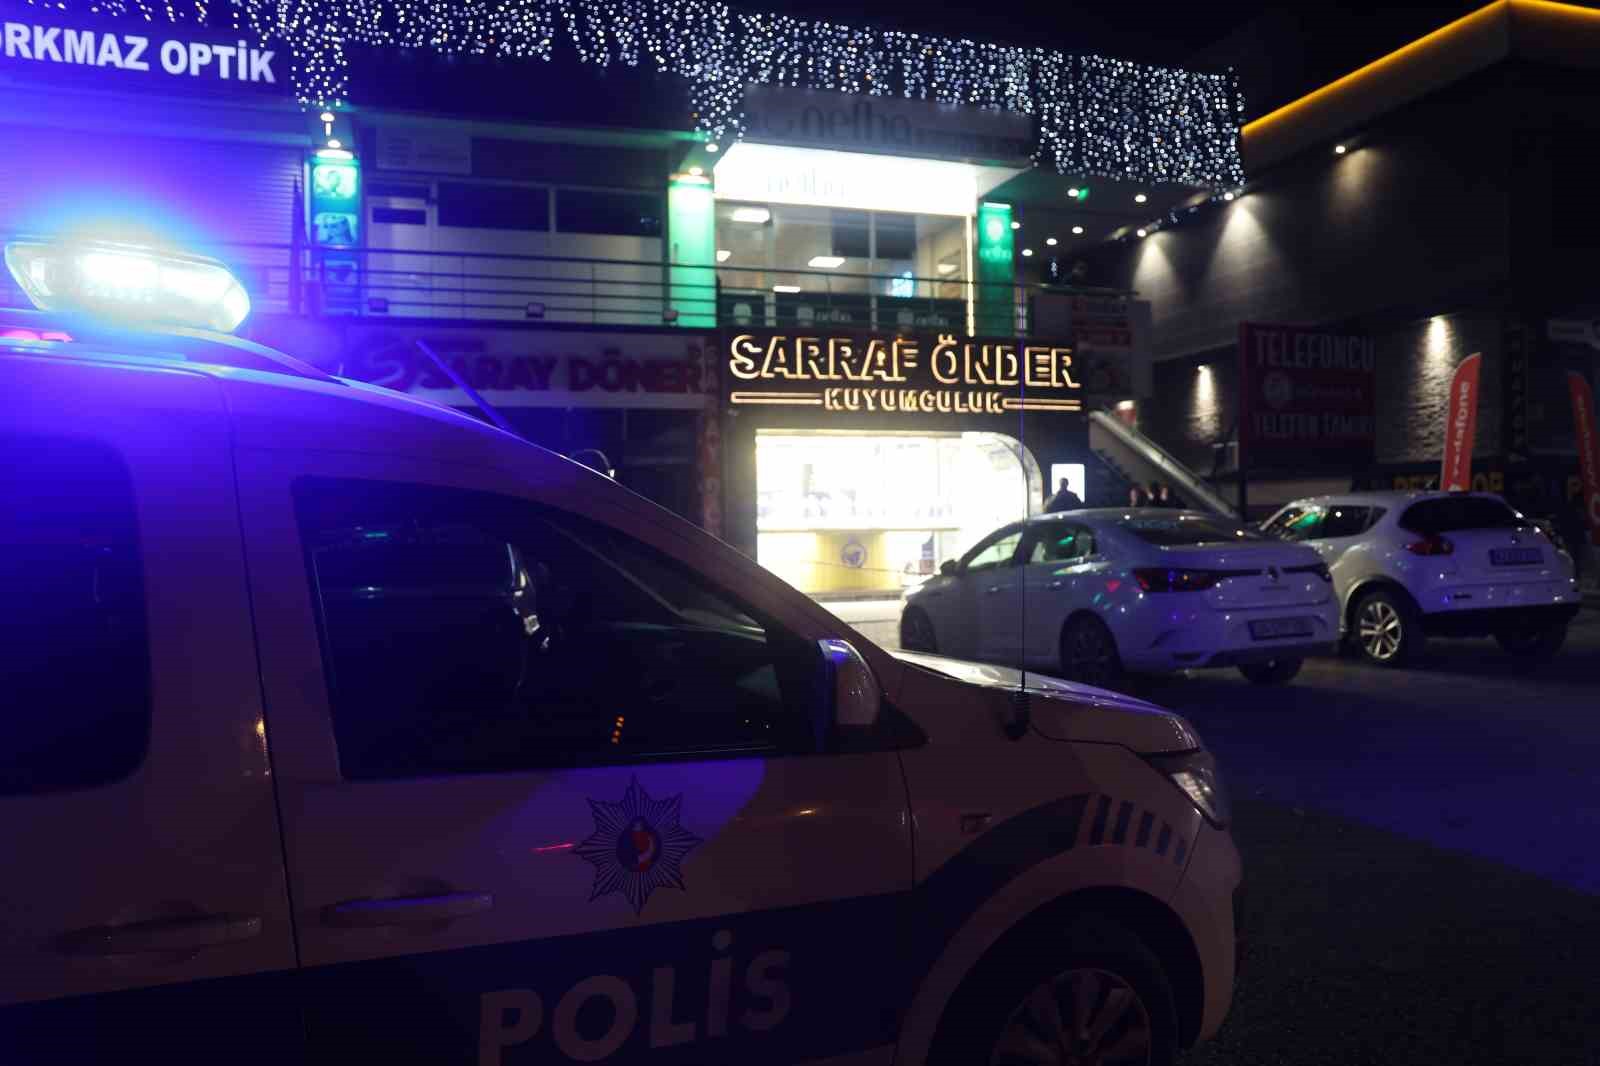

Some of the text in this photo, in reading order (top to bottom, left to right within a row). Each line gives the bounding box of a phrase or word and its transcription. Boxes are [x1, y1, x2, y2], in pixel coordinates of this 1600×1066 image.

[0, 22, 276, 83] RKMAZ OPTİK
[729, 334, 1081, 388] SARRAF ÖNDER
[824, 387, 1004, 414] KUYUMCULUK
[478, 928, 793, 1066] POLİS
